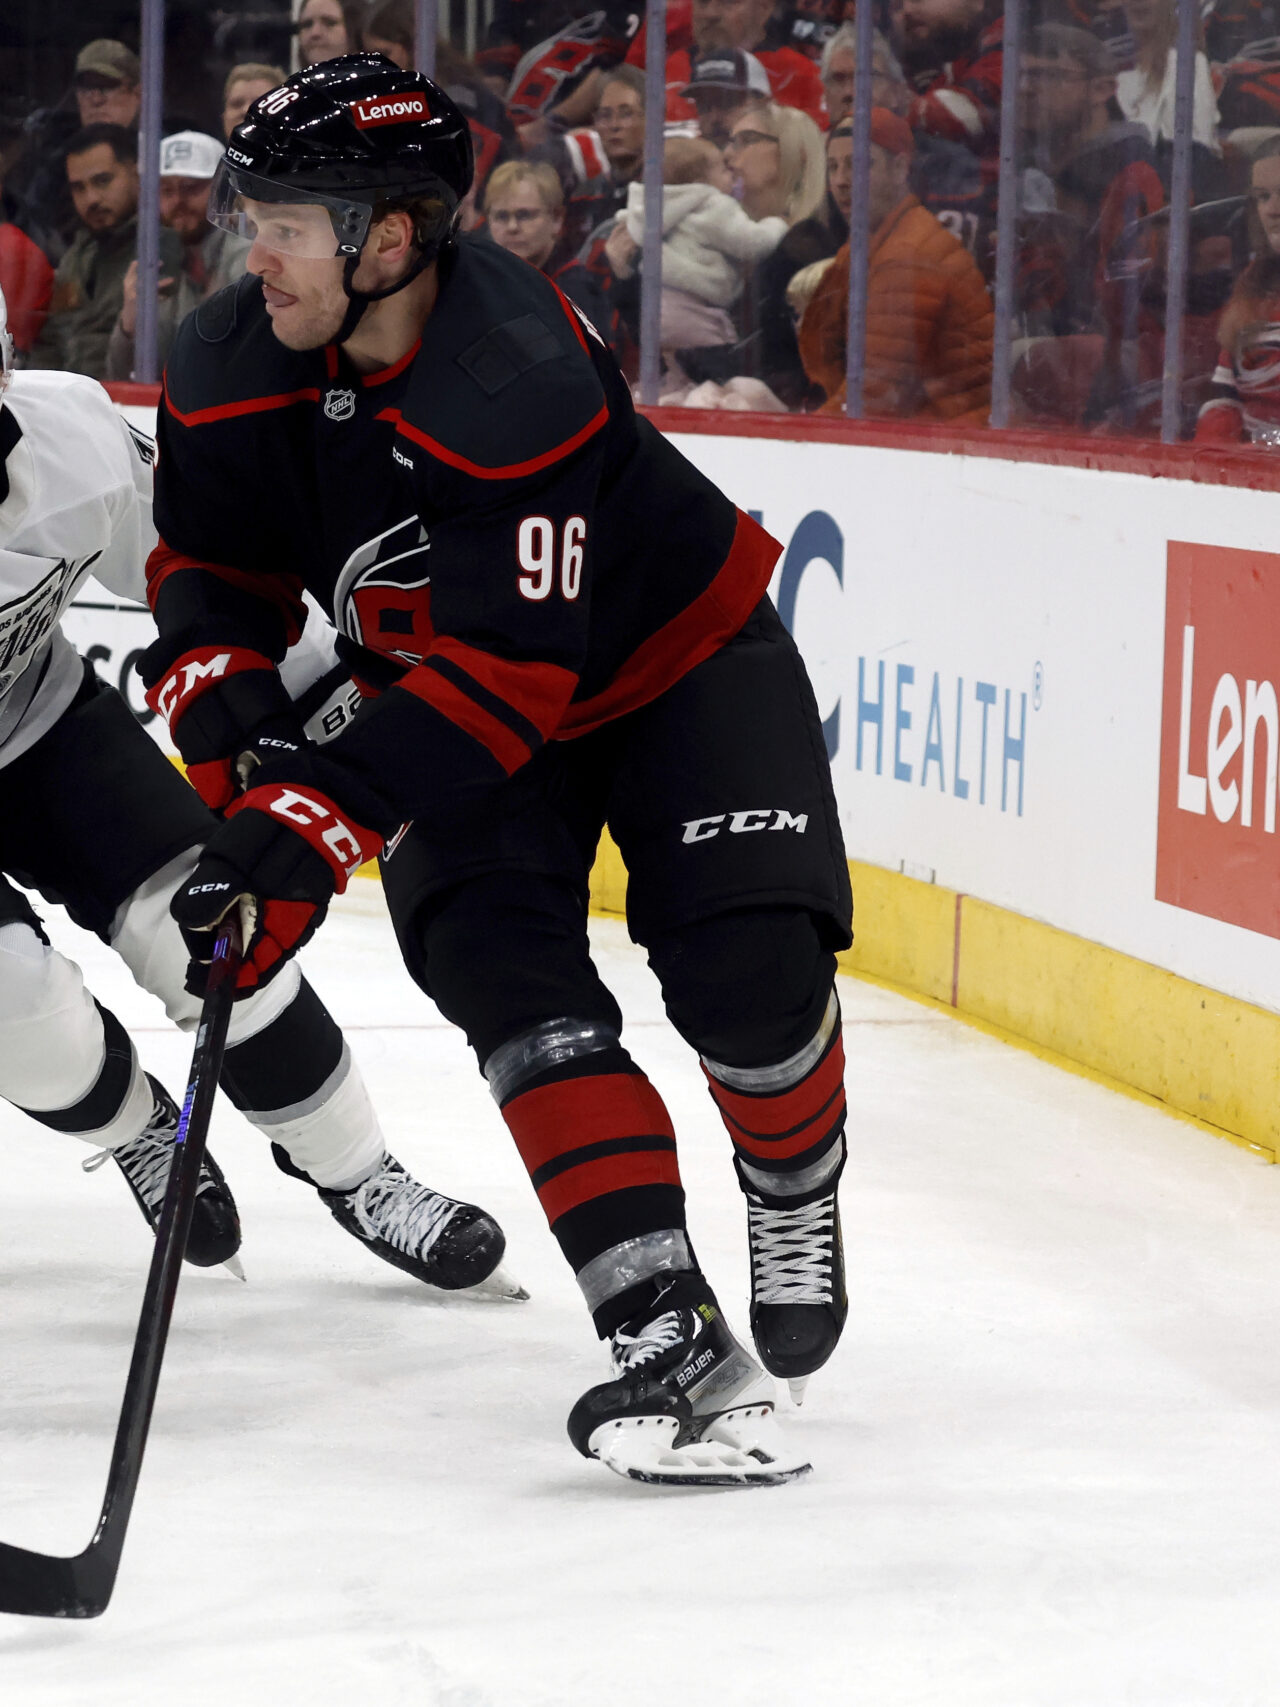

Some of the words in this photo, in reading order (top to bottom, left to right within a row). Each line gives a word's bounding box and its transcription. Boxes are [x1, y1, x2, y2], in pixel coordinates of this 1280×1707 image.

[258, 86, 300, 115] 96
[357, 100, 424, 122] Lenovo
[227, 146, 254, 167] CCM
[516, 515, 588, 601] 96
[258, 737, 299, 751] CCM
[855, 656, 1027, 818] HEALTH
[269, 789, 363, 877] CC
[680, 809, 809, 844] CCM
[188, 883, 230, 896] CCM
[676, 1348, 716, 1388] BAUER
